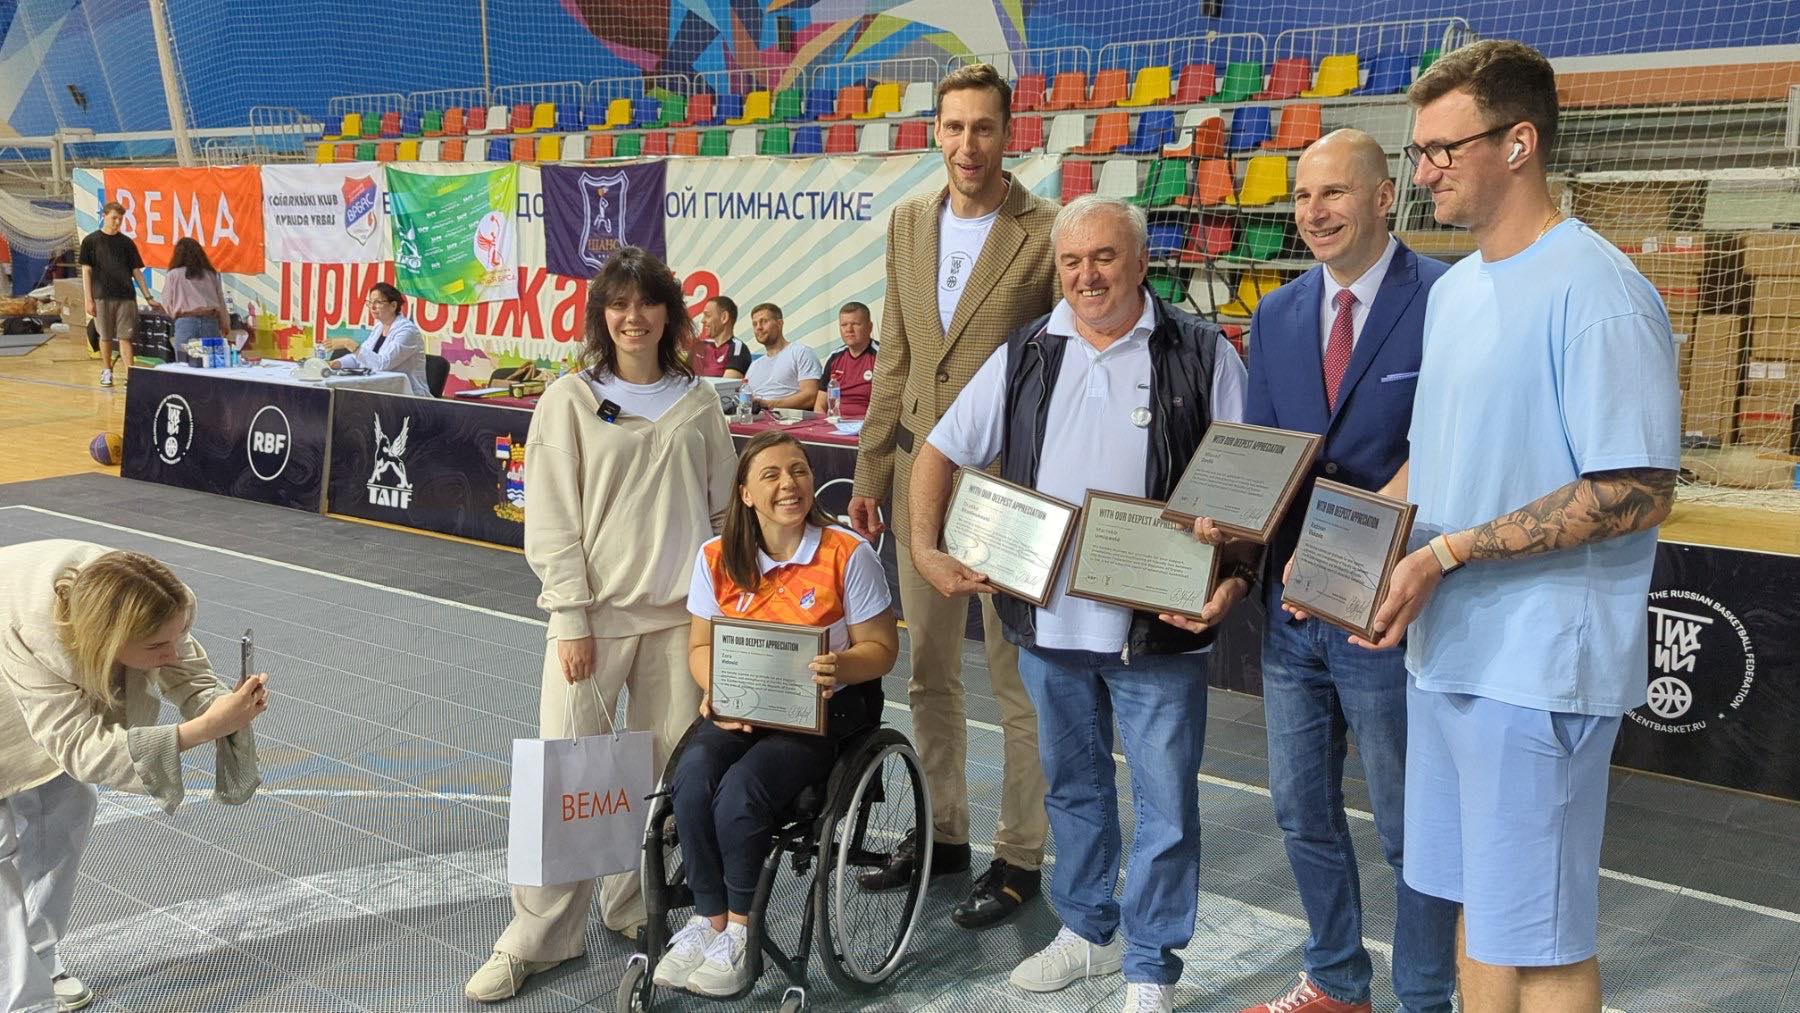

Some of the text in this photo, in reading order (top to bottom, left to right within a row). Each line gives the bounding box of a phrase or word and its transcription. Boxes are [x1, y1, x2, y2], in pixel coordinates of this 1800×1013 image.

[703, 191, 874, 221] ГИМНАСТИКЕ
[253, 431, 287, 455] RBF
[367, 486, 413, 509] TAIF
[1648, 590, 1755, 710] THE RUSSIAN BASKETBALL FEDERATION
[1624, 708, 1707, 733] SILENTBASKET.RU
